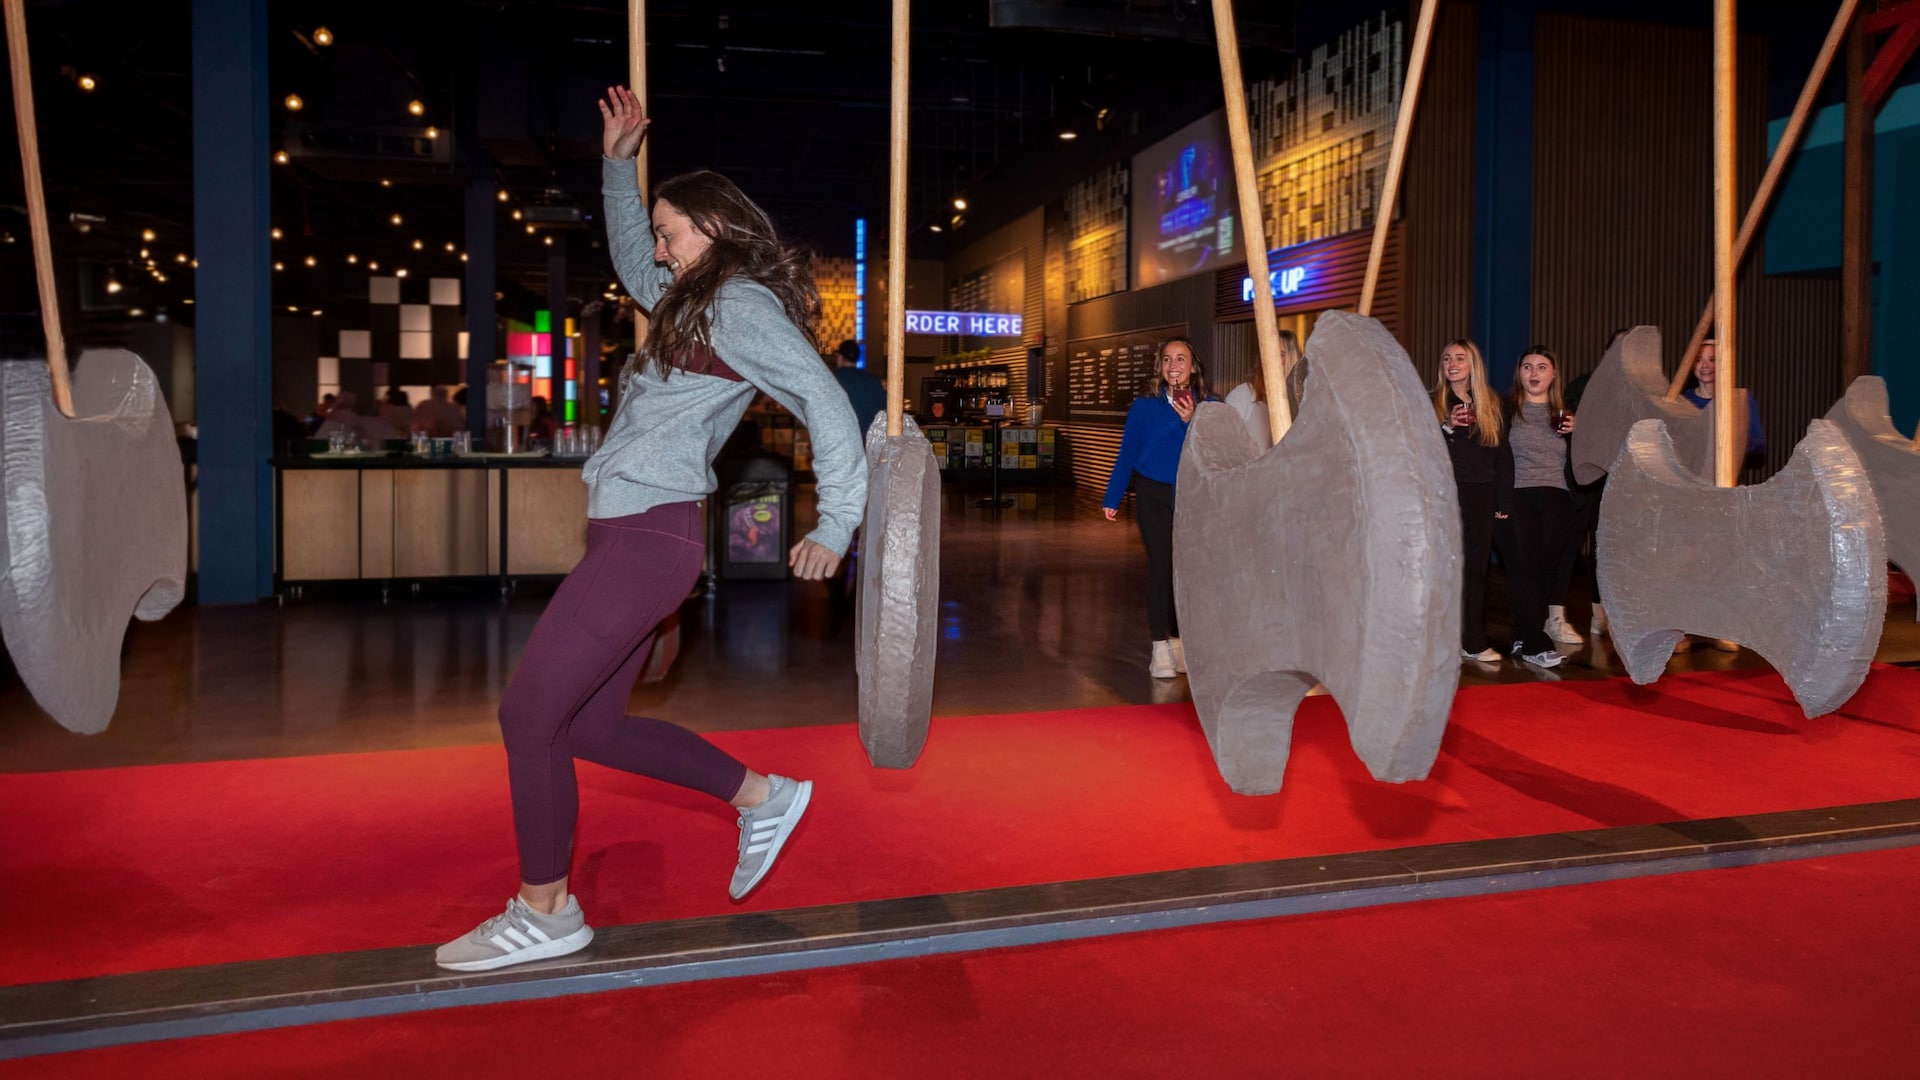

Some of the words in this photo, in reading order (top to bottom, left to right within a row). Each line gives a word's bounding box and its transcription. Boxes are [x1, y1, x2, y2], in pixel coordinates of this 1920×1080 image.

[1243, 272, 1277, 301] PK
[1281, 266, 1305, 294] UP
[906, 314, 960, 333] RDER
[970, 316, 1023, 334] HERE
